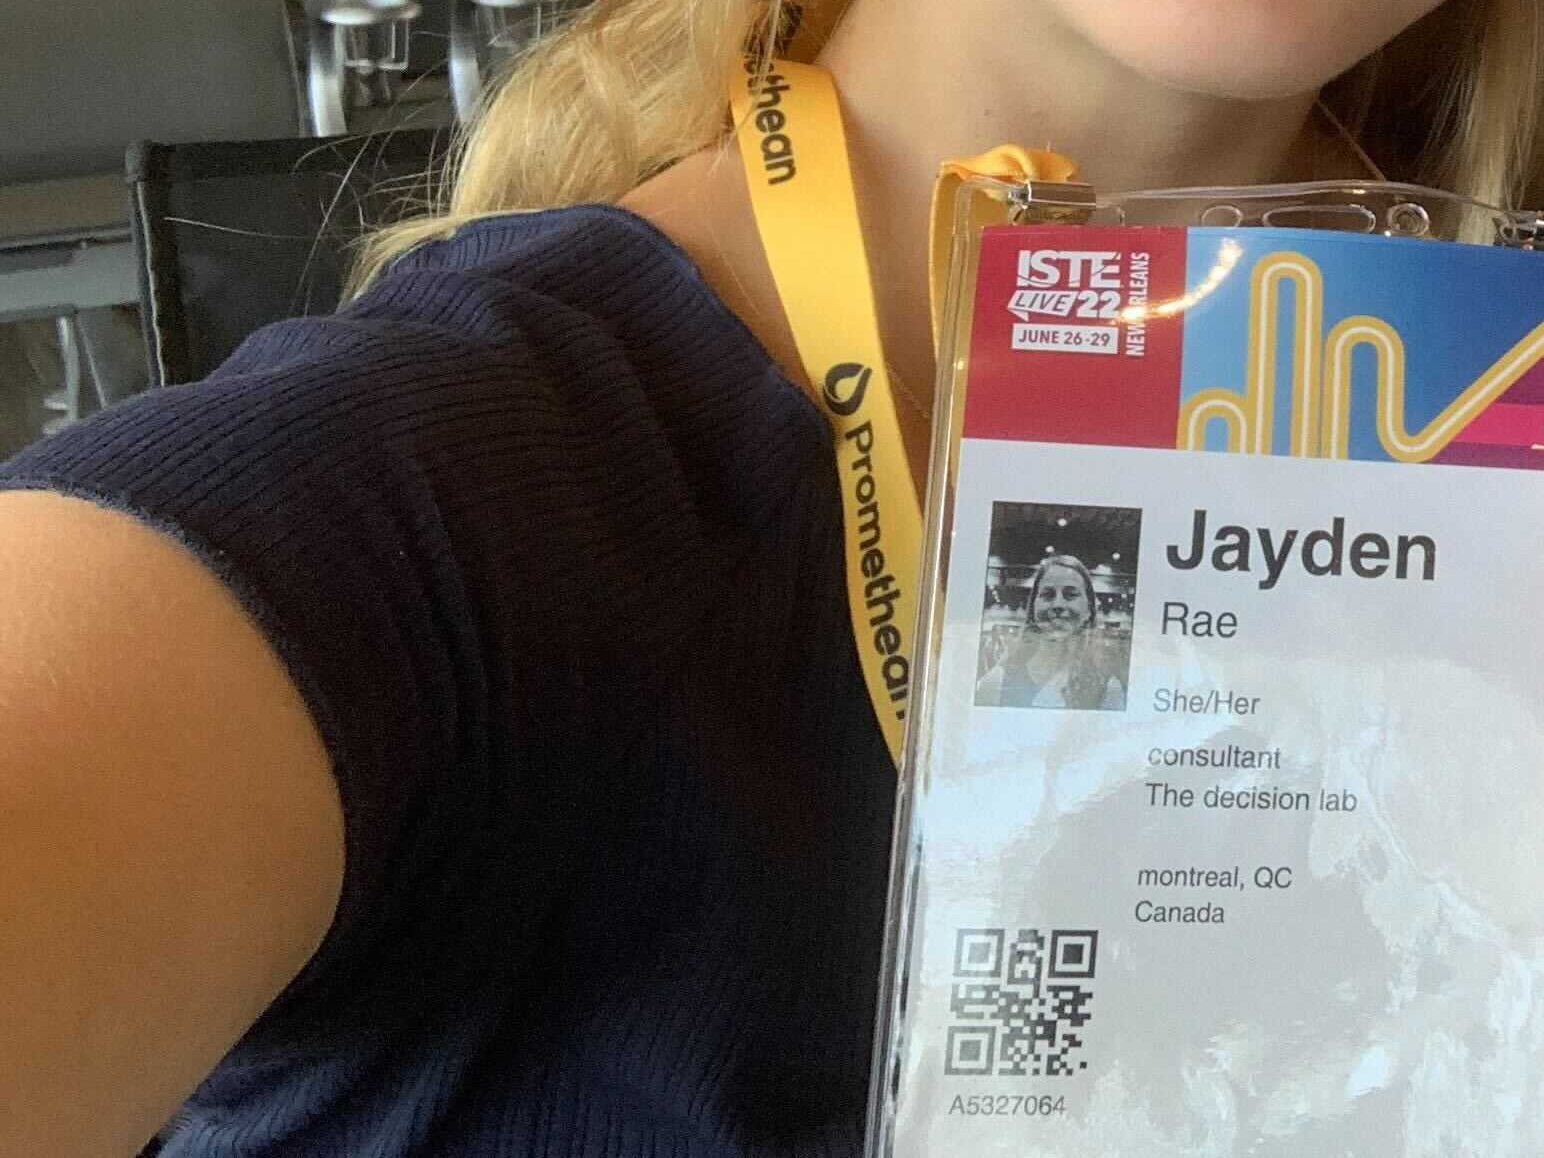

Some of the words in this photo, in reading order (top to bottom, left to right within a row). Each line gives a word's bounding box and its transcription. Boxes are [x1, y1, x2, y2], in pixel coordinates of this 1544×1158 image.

[1017, 249, 1121, 288] ISTE
[1127, 252, 1150, 316] RLEANS
[1015, 292, 1071, 313] LIVE
[1076, 290, 1121, 319] 22
[1018, 329, 1060, 344] JUNE
[1165, 509, 1437, 590] Jayden
[1161, 601, 1239, 638] Rae
[1153, 688, 1261, 715] She/Her
[1147, 744, 1281, 770] consultant
[1145, 782, 1194, 808] The
[1203, 786, 1310, 811] decision
[1319, 789, 1358, 813] lab
[1137, 865, 1245, 891] montreal,
[1253, 866, 1293, 889] QC
[1135, 900, 1225, 924] Canada
[948, 1094, 1067, 1117] A5327064
